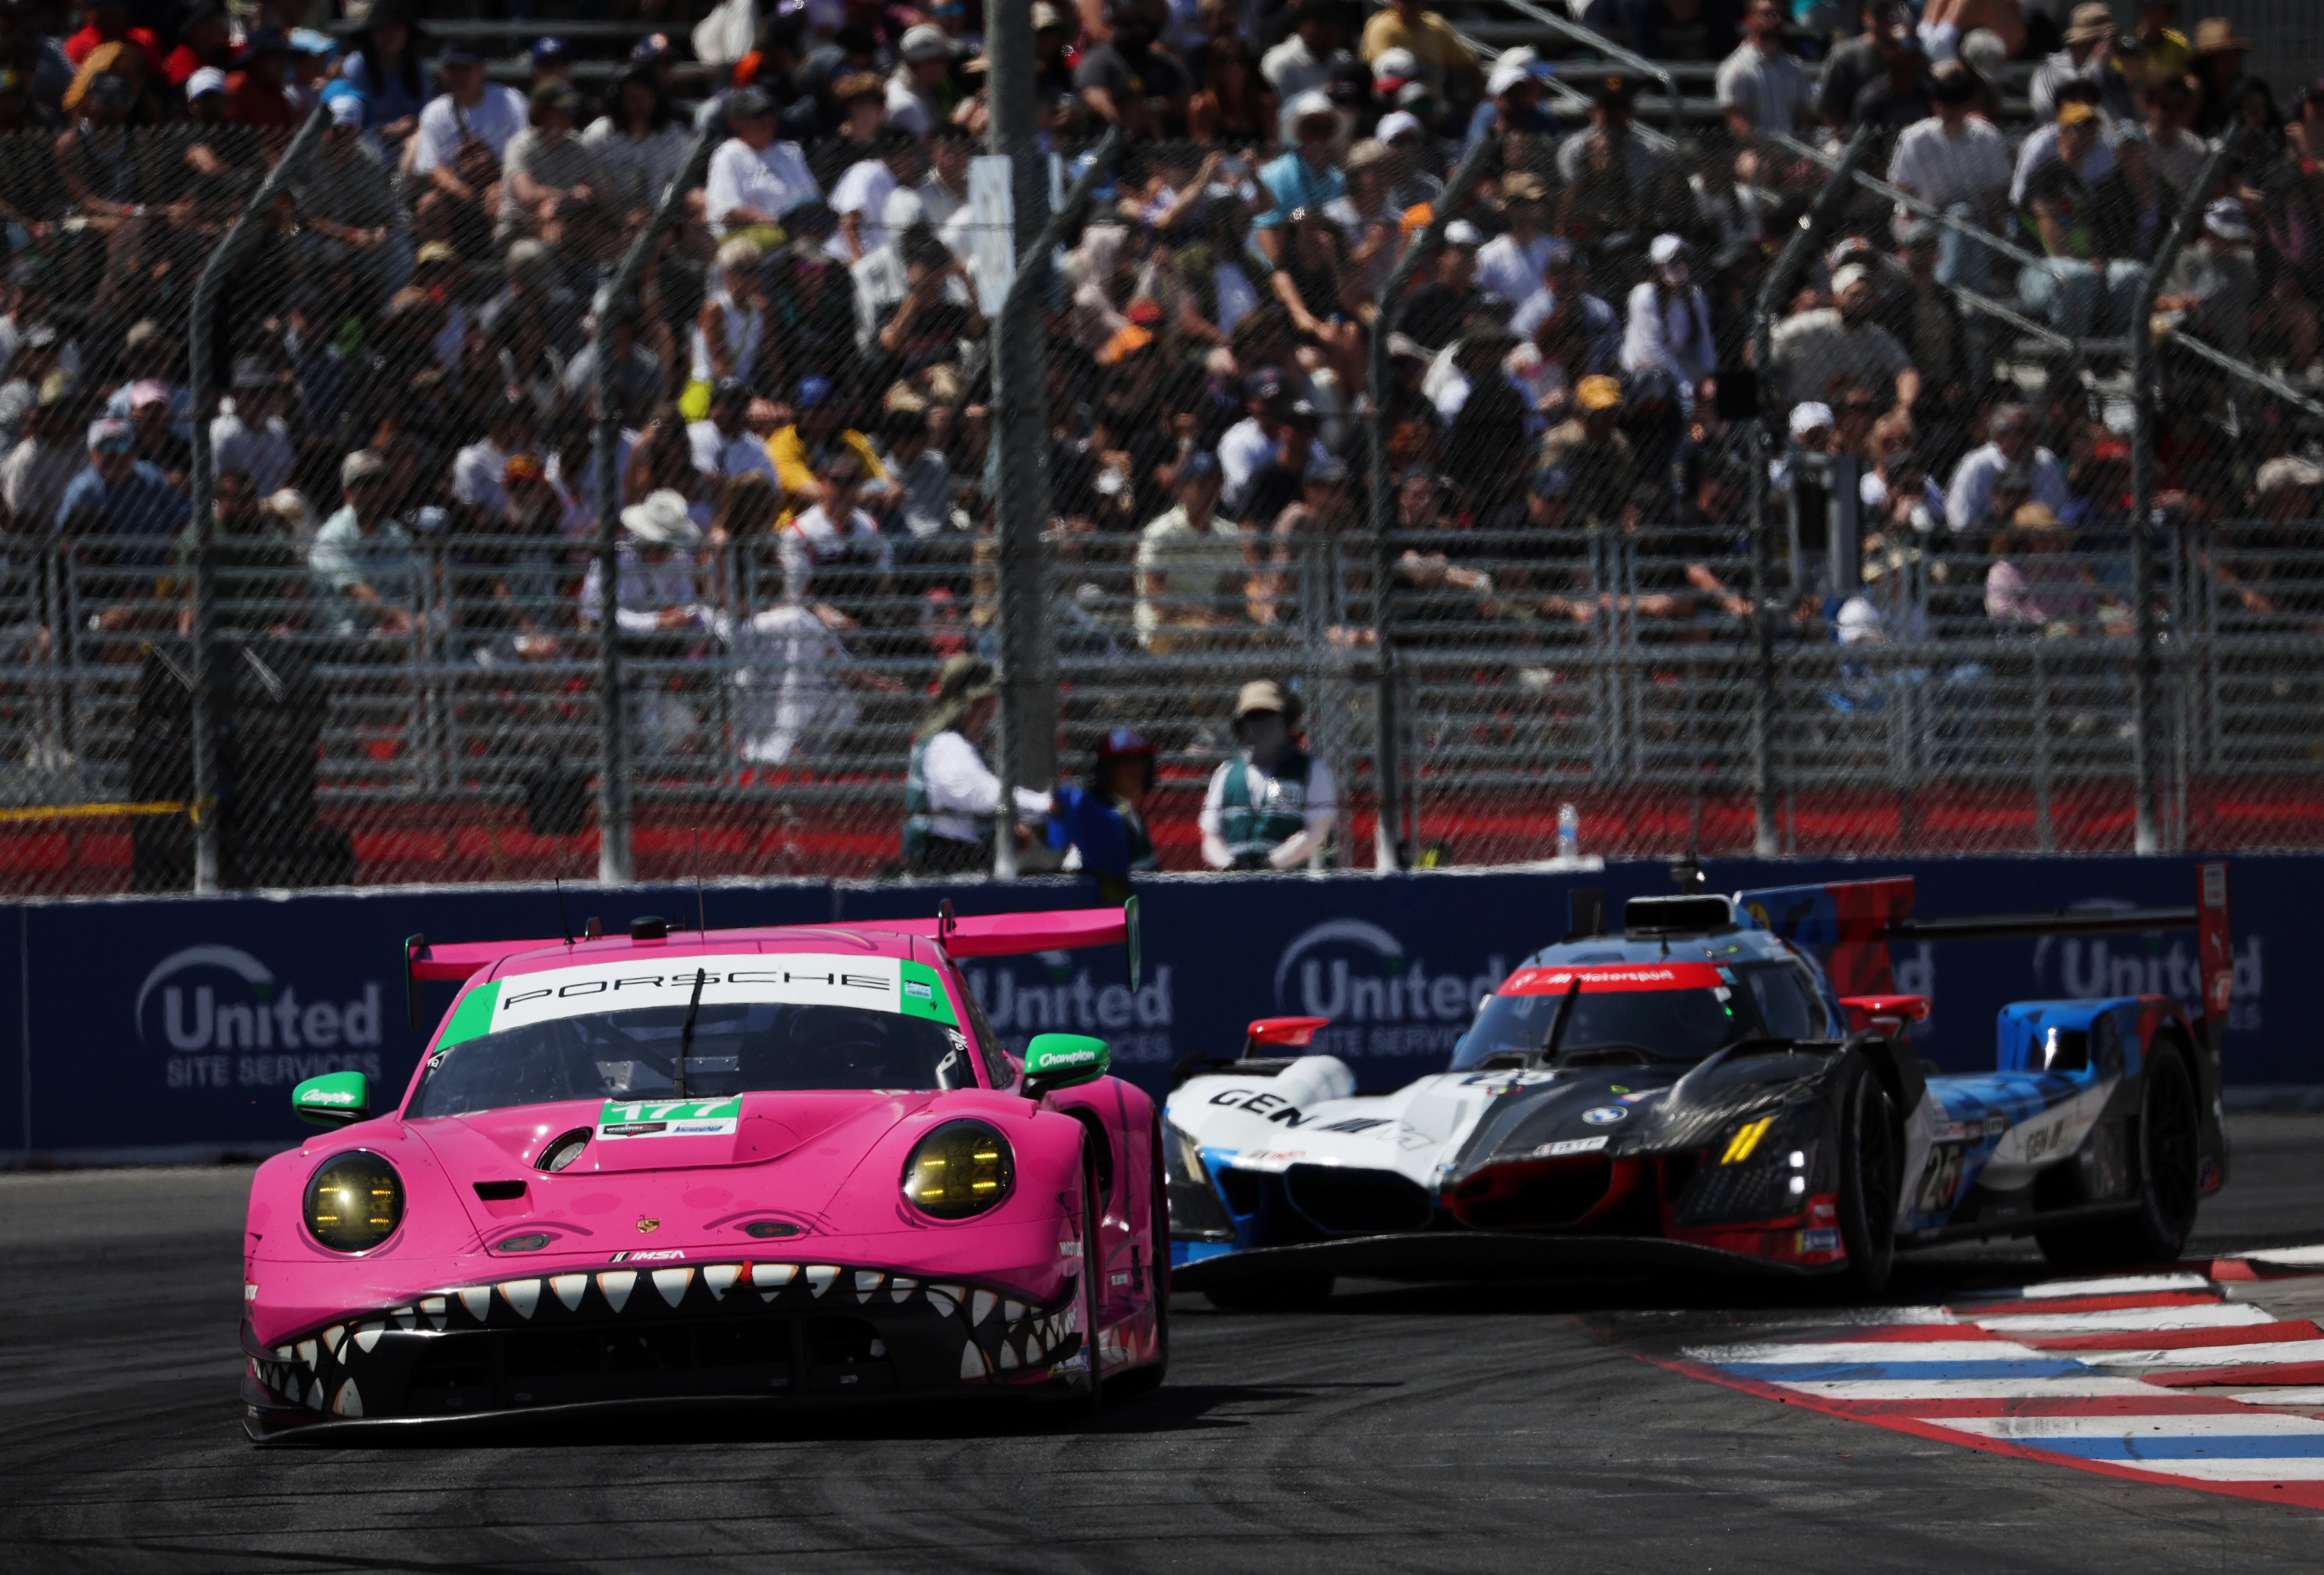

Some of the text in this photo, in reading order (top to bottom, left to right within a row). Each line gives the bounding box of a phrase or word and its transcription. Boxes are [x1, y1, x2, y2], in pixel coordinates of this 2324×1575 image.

[503, 972, 890, 1010] PORSCHE
[968, 964, 1173, 1029] United
[1301, 953, 1506, 1022] United
[163, 980, 382, 1051] United
[166, 1054, 231, 1088] SITE
[1039, 1050, 1095, 1067] Champion
[611, 1100, 733, 1121] 177
[1208, 1089, 1319, 1129] GEN
[1920, 1145, 1960, 1209] 25
[631, 1250, 685, 1260] IMSA
